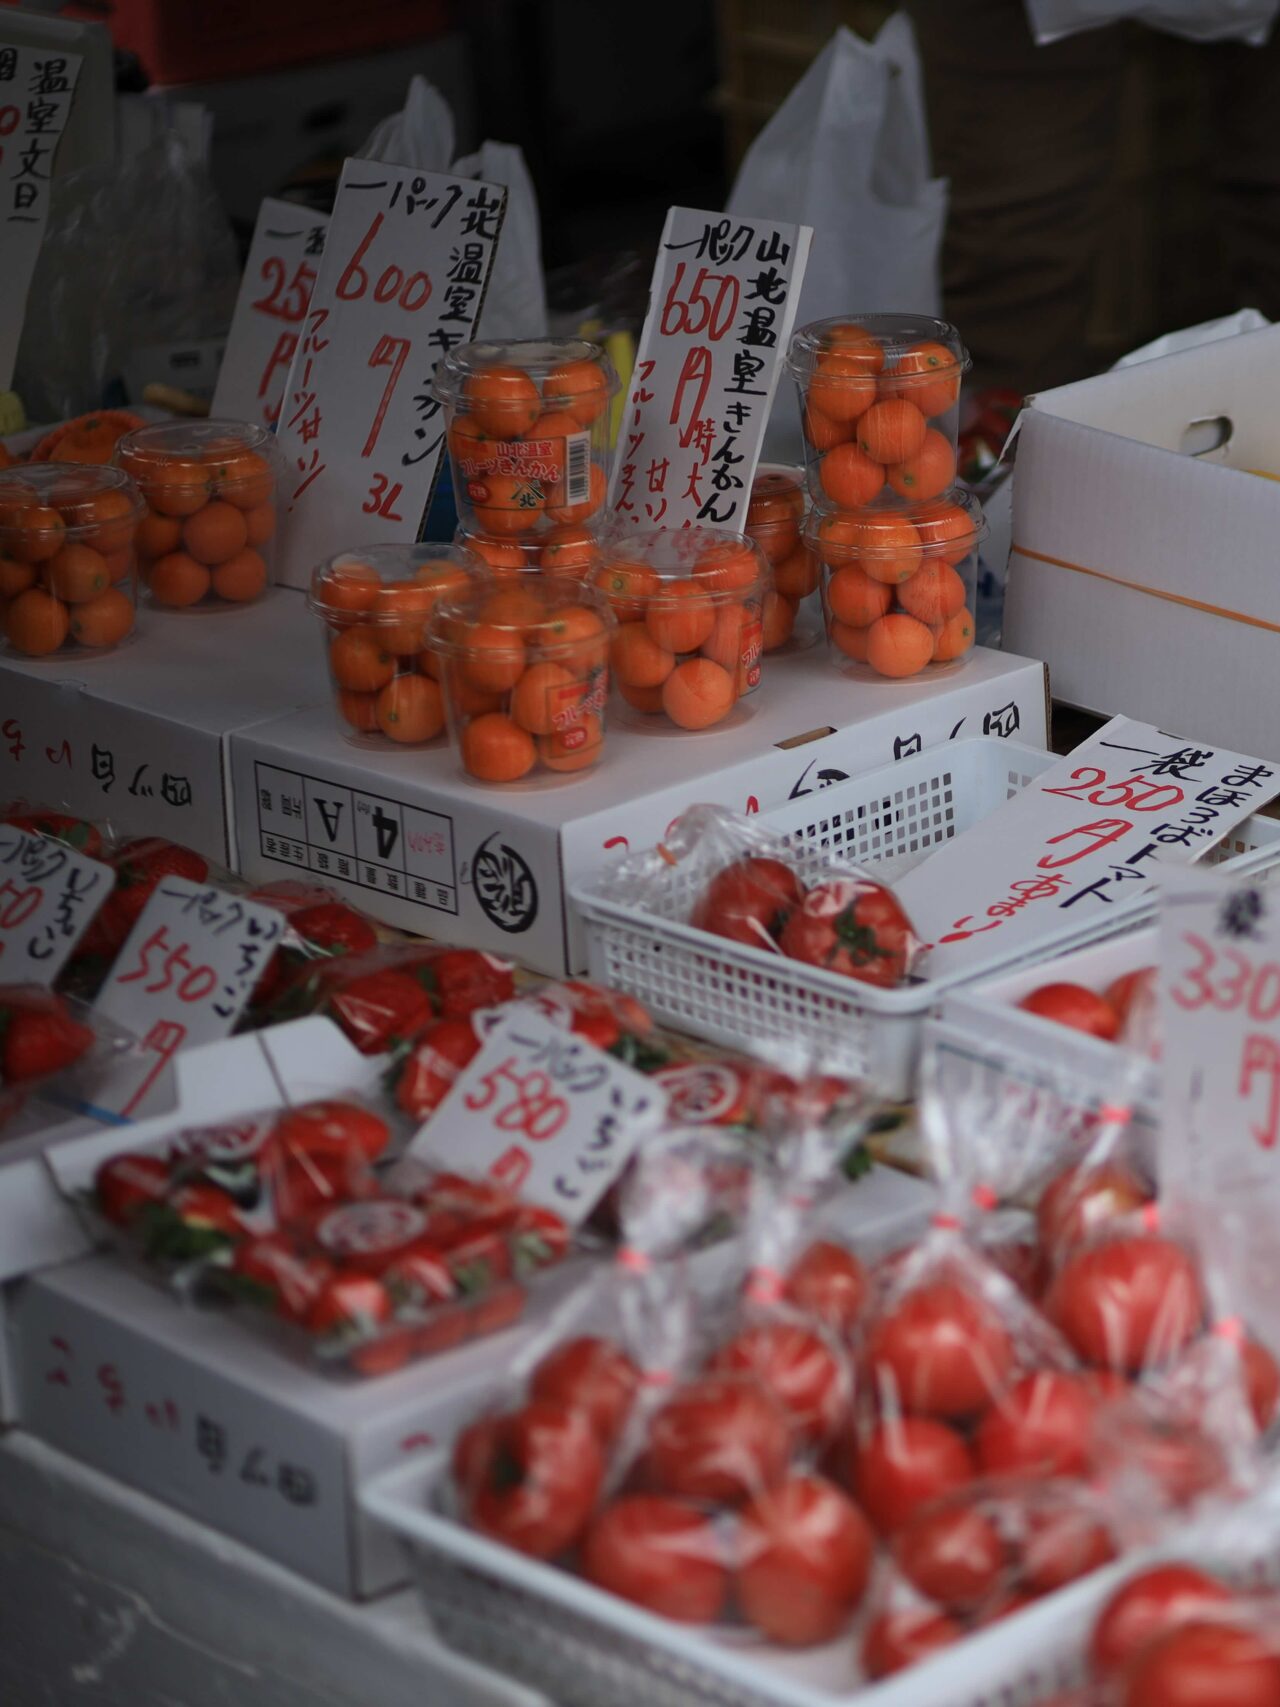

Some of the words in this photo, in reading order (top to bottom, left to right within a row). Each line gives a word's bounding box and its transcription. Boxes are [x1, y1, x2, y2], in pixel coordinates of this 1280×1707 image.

[335, 212, 432, 311] 600
[660, 262, 740, 342] 650
[669, 346, 712, 448] 円
[1042, 767, 1185, 812] 250
[117, 925, 217, 1002] 550
[464, 1057, 568, 1140] 580
